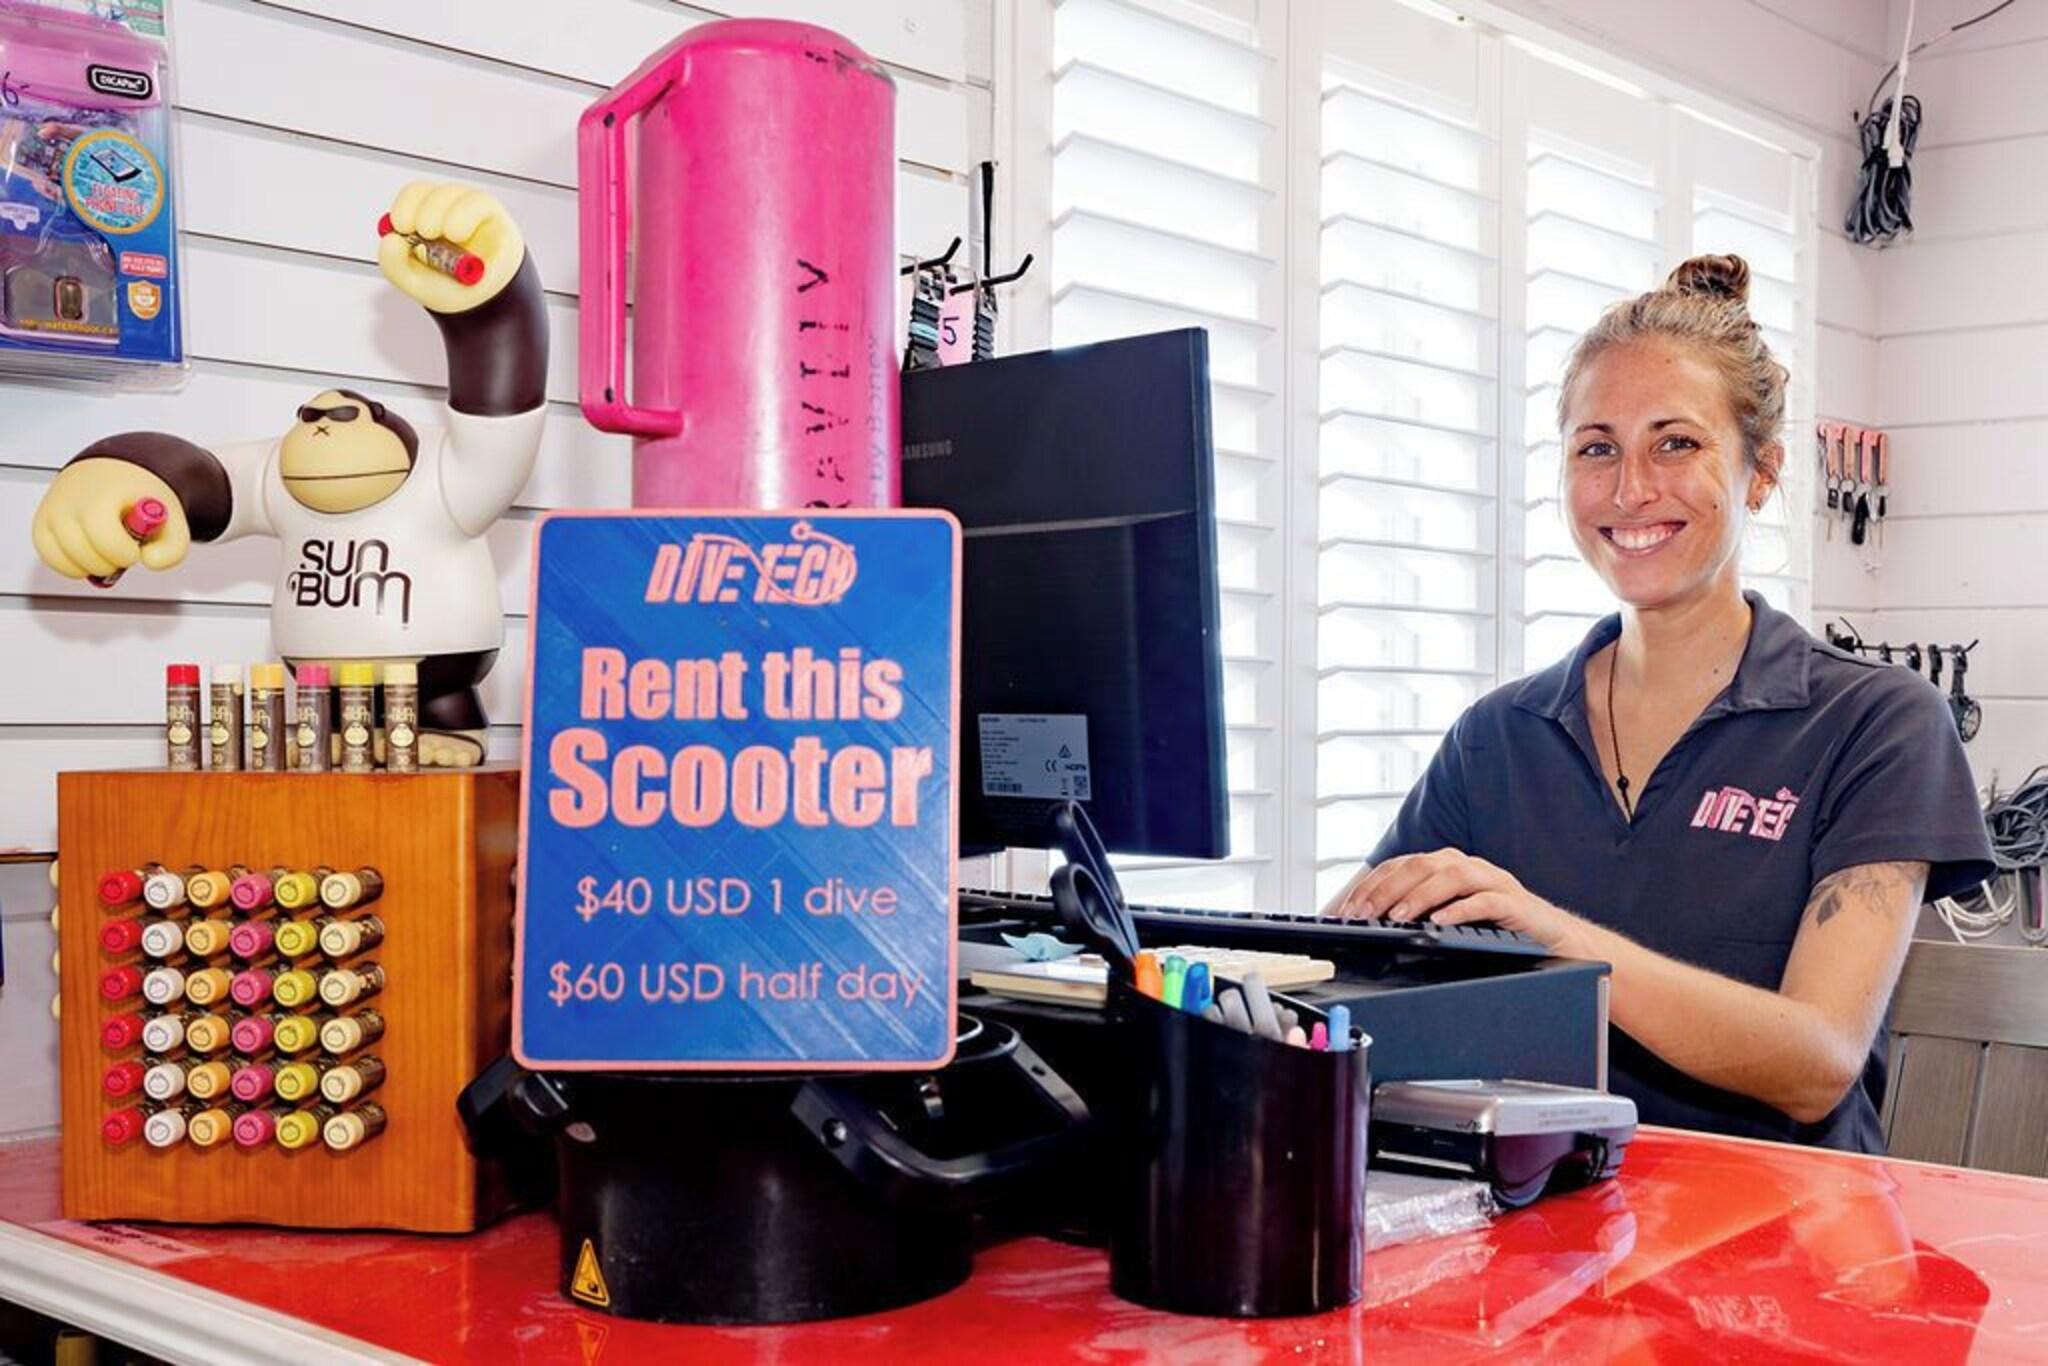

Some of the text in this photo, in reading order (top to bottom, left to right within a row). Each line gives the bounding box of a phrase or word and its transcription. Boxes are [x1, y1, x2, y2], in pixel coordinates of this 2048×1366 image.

[943, 316, 960, 346] 5
[902, 440, 953, 460] AMSUNG
[580, 646, 903, 721] Rent this
[548, 727, 933, 828] Scooter
[575, 875, 898, 923] $40 USD 1 dive
[548, 961, 923, 1007] $60 USD half day
